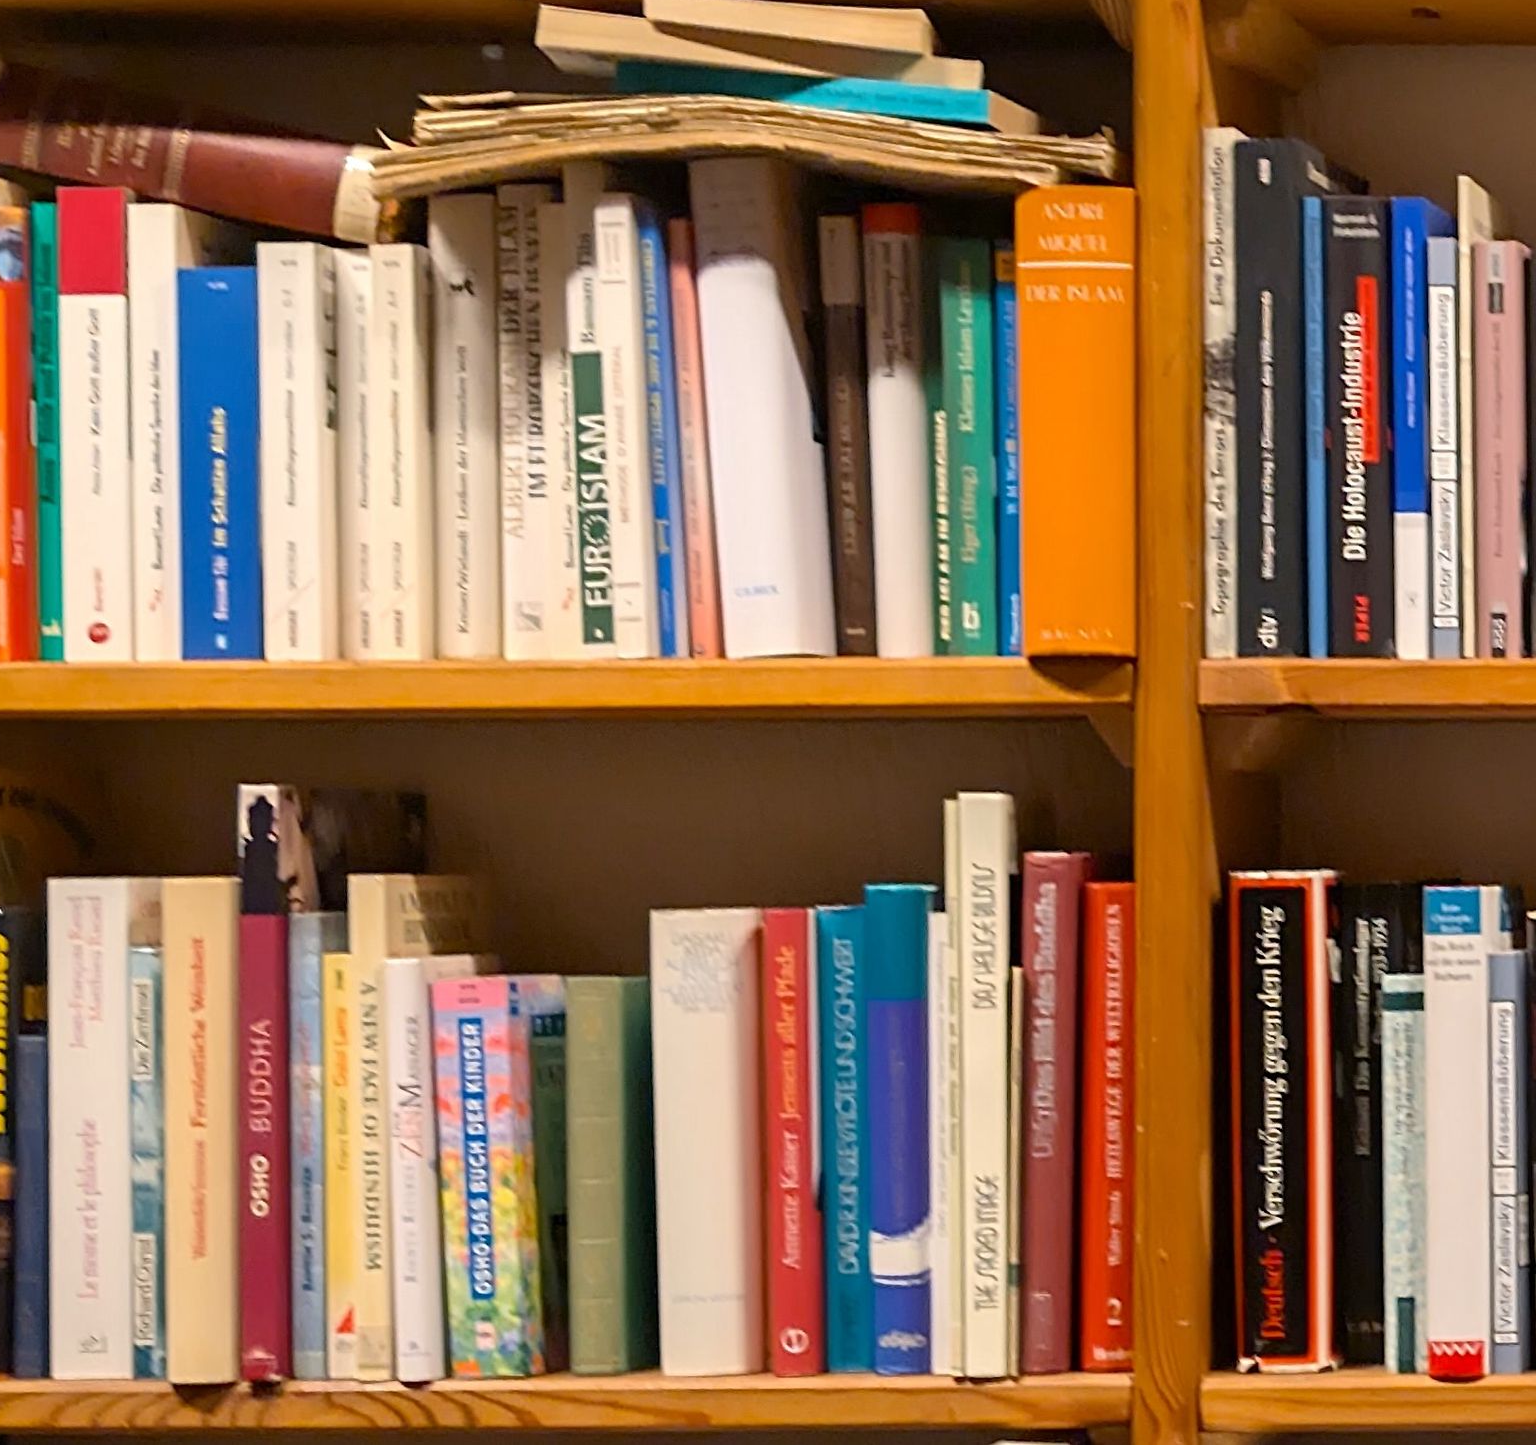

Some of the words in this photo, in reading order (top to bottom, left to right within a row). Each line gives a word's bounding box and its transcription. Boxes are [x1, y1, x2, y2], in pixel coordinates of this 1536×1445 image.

[1340, 312, 1366, 521] Holocaust-Industrie
[1342, 525, 1366, 560] Die
[1256, 905, 1286, 965] Krieg
[1257, 969, 1283, 1006] den
[1260, 1010, 1290, 1072] gegen
[249, 1018, 273, 1132] BUDDHA
[1257, 1078, 1289, 1230] Verschwörung
[250, 1154, 272, 1217] OSHO
